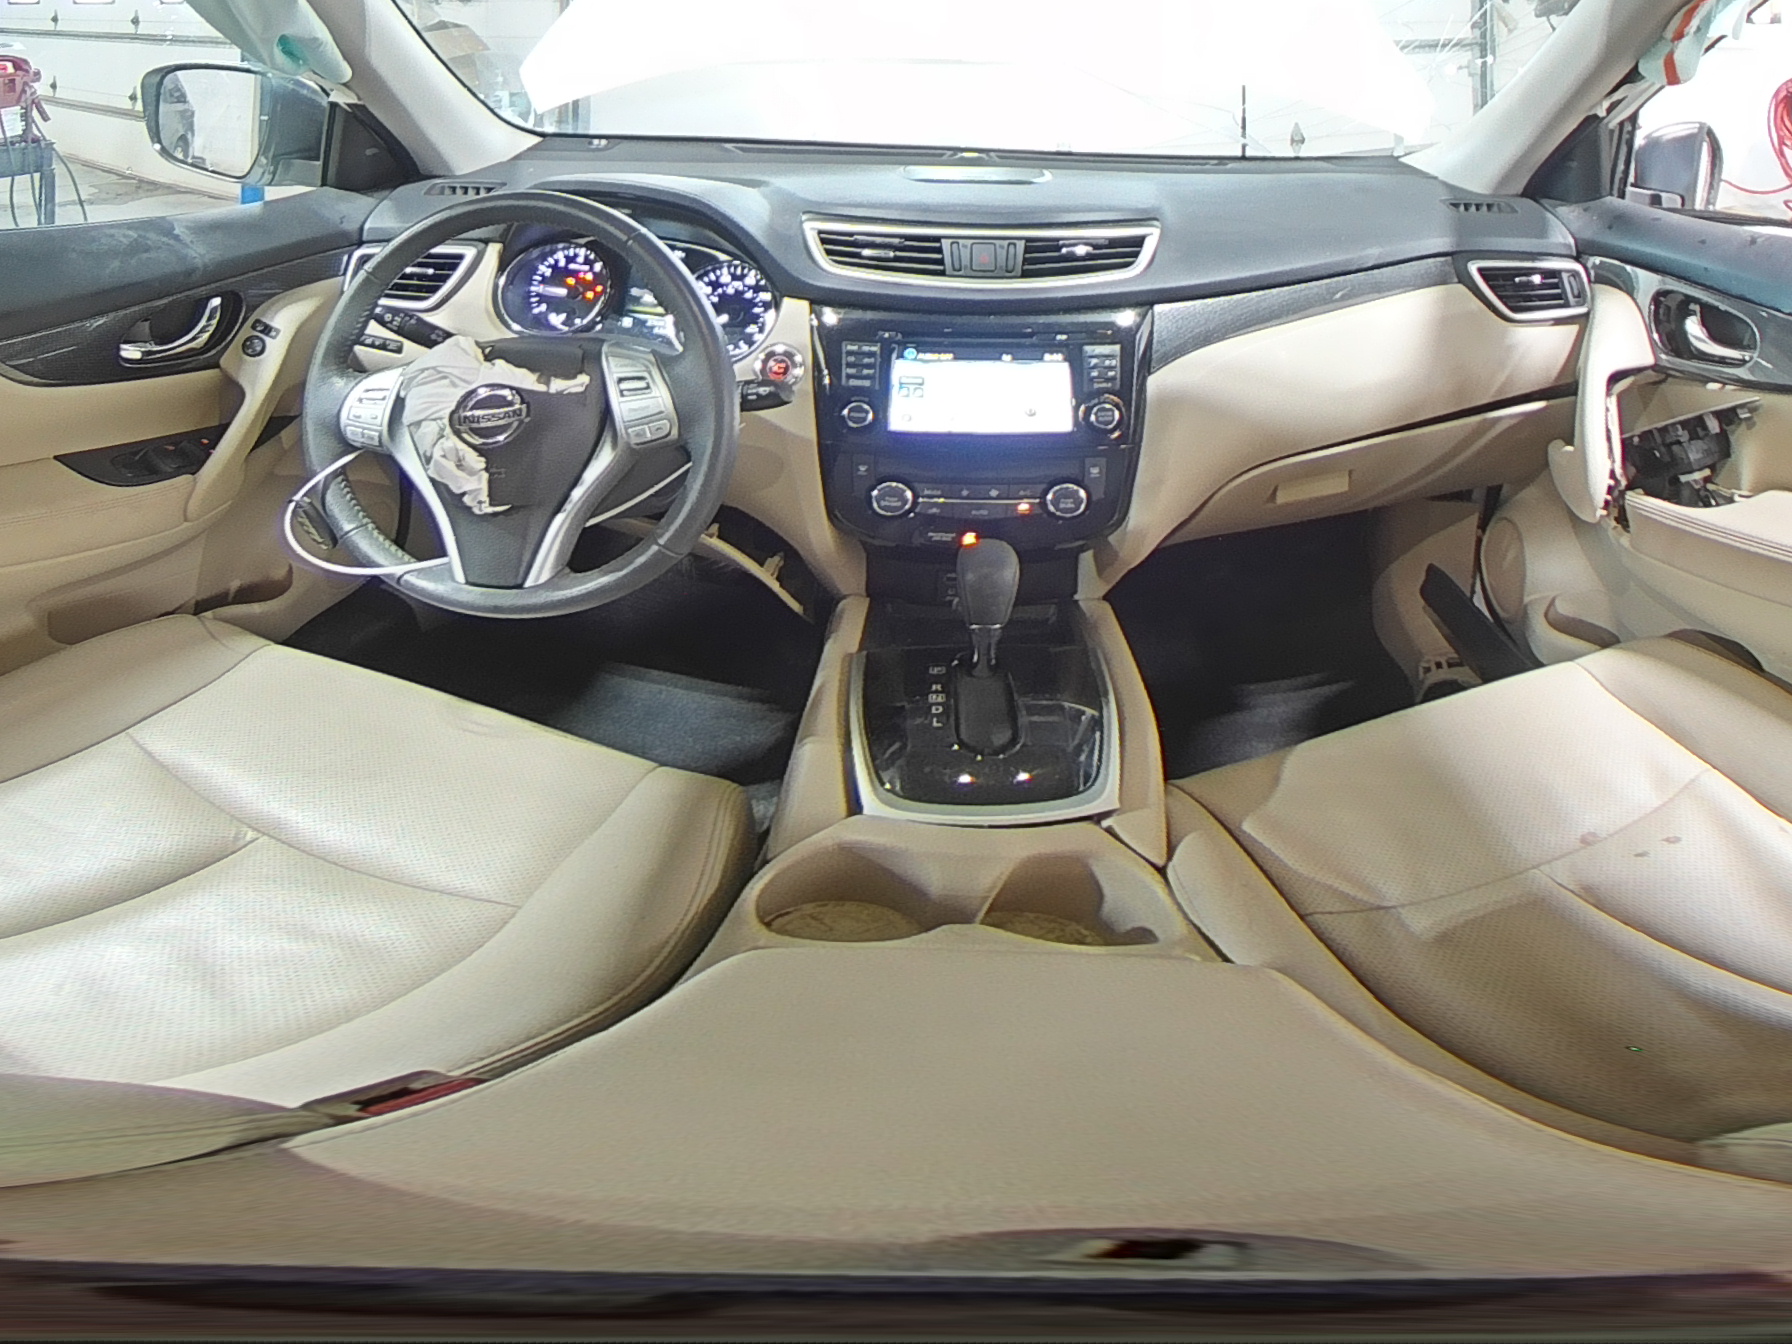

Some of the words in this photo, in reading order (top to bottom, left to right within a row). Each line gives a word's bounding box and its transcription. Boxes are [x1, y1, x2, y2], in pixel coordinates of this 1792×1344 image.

[462, 407, 523, 425] NISSAN
[931, 705, 943, 714] D
[932, 717, 943, 727] L
